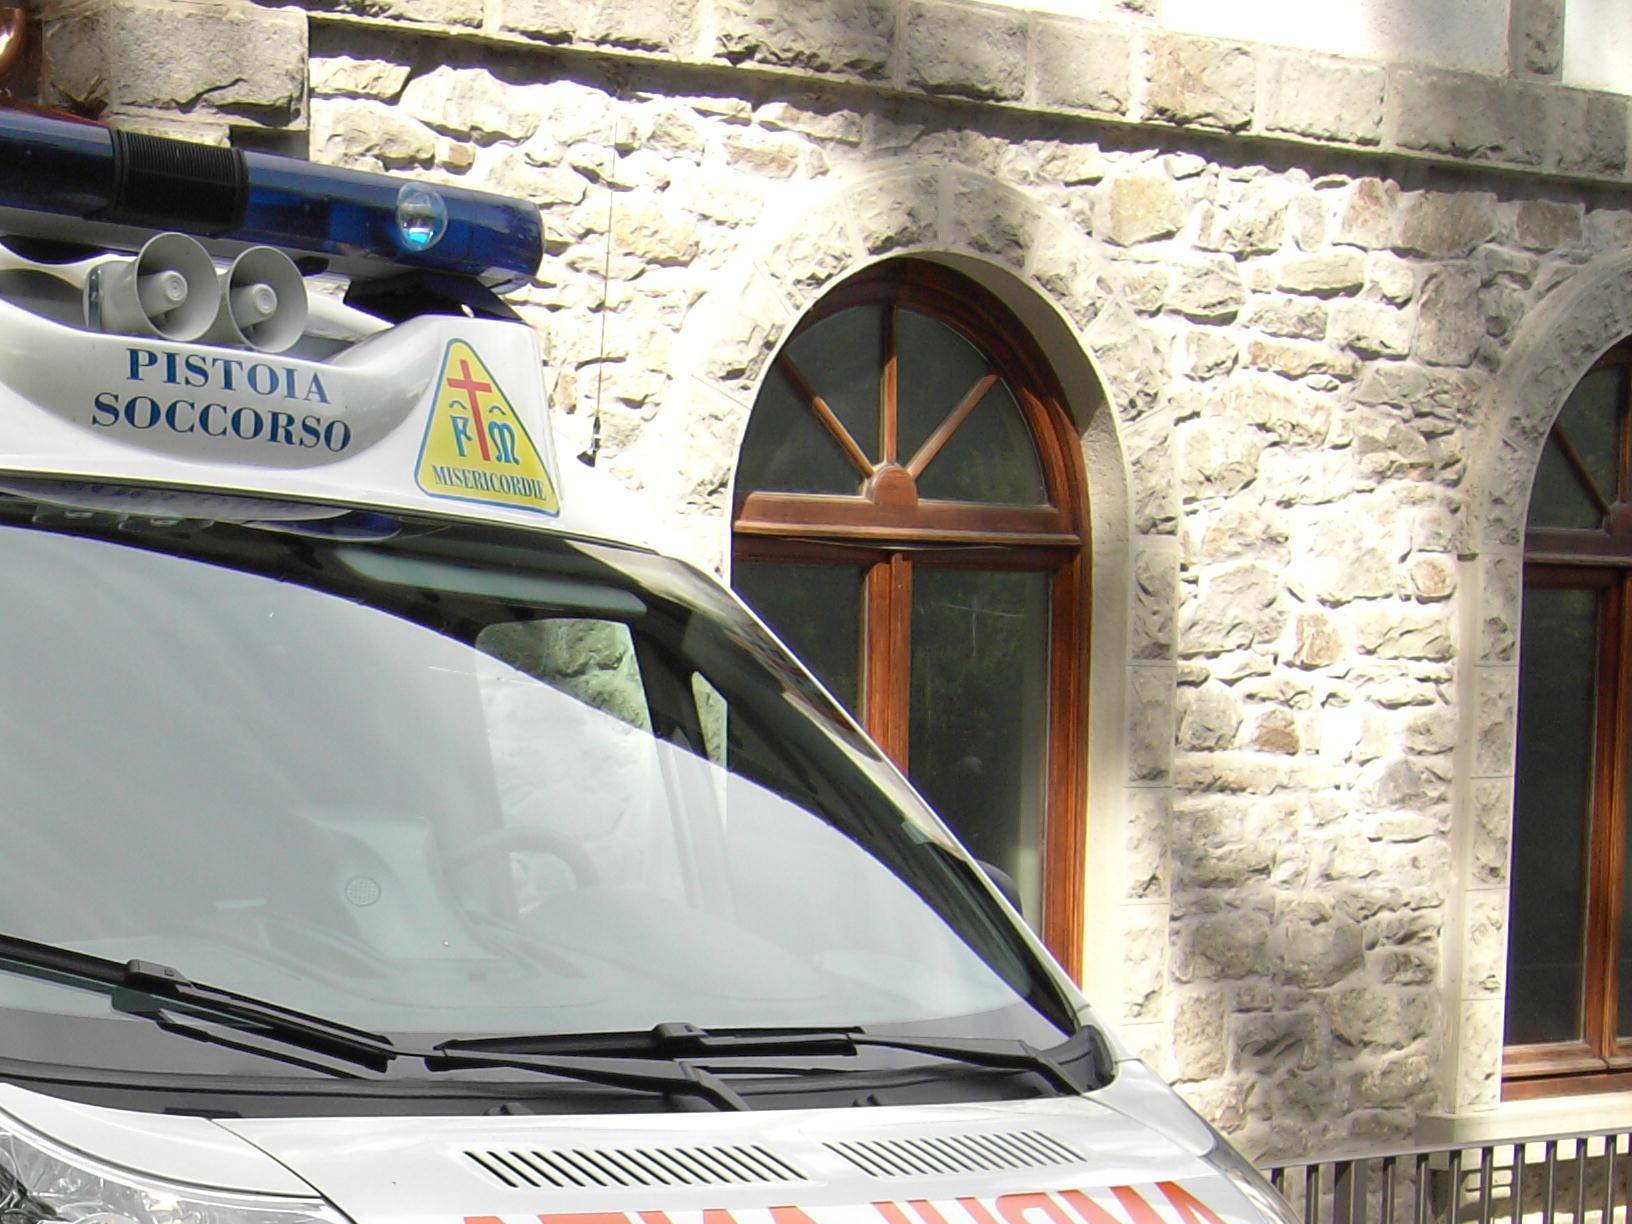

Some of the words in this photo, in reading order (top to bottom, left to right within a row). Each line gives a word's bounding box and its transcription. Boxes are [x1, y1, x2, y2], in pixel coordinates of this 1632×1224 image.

[126, 347, 332, 405] PISTOIA
[91, 391, 352, 453] SOCCORSO
[431, 464, 547, 501] MISERICORDIE
